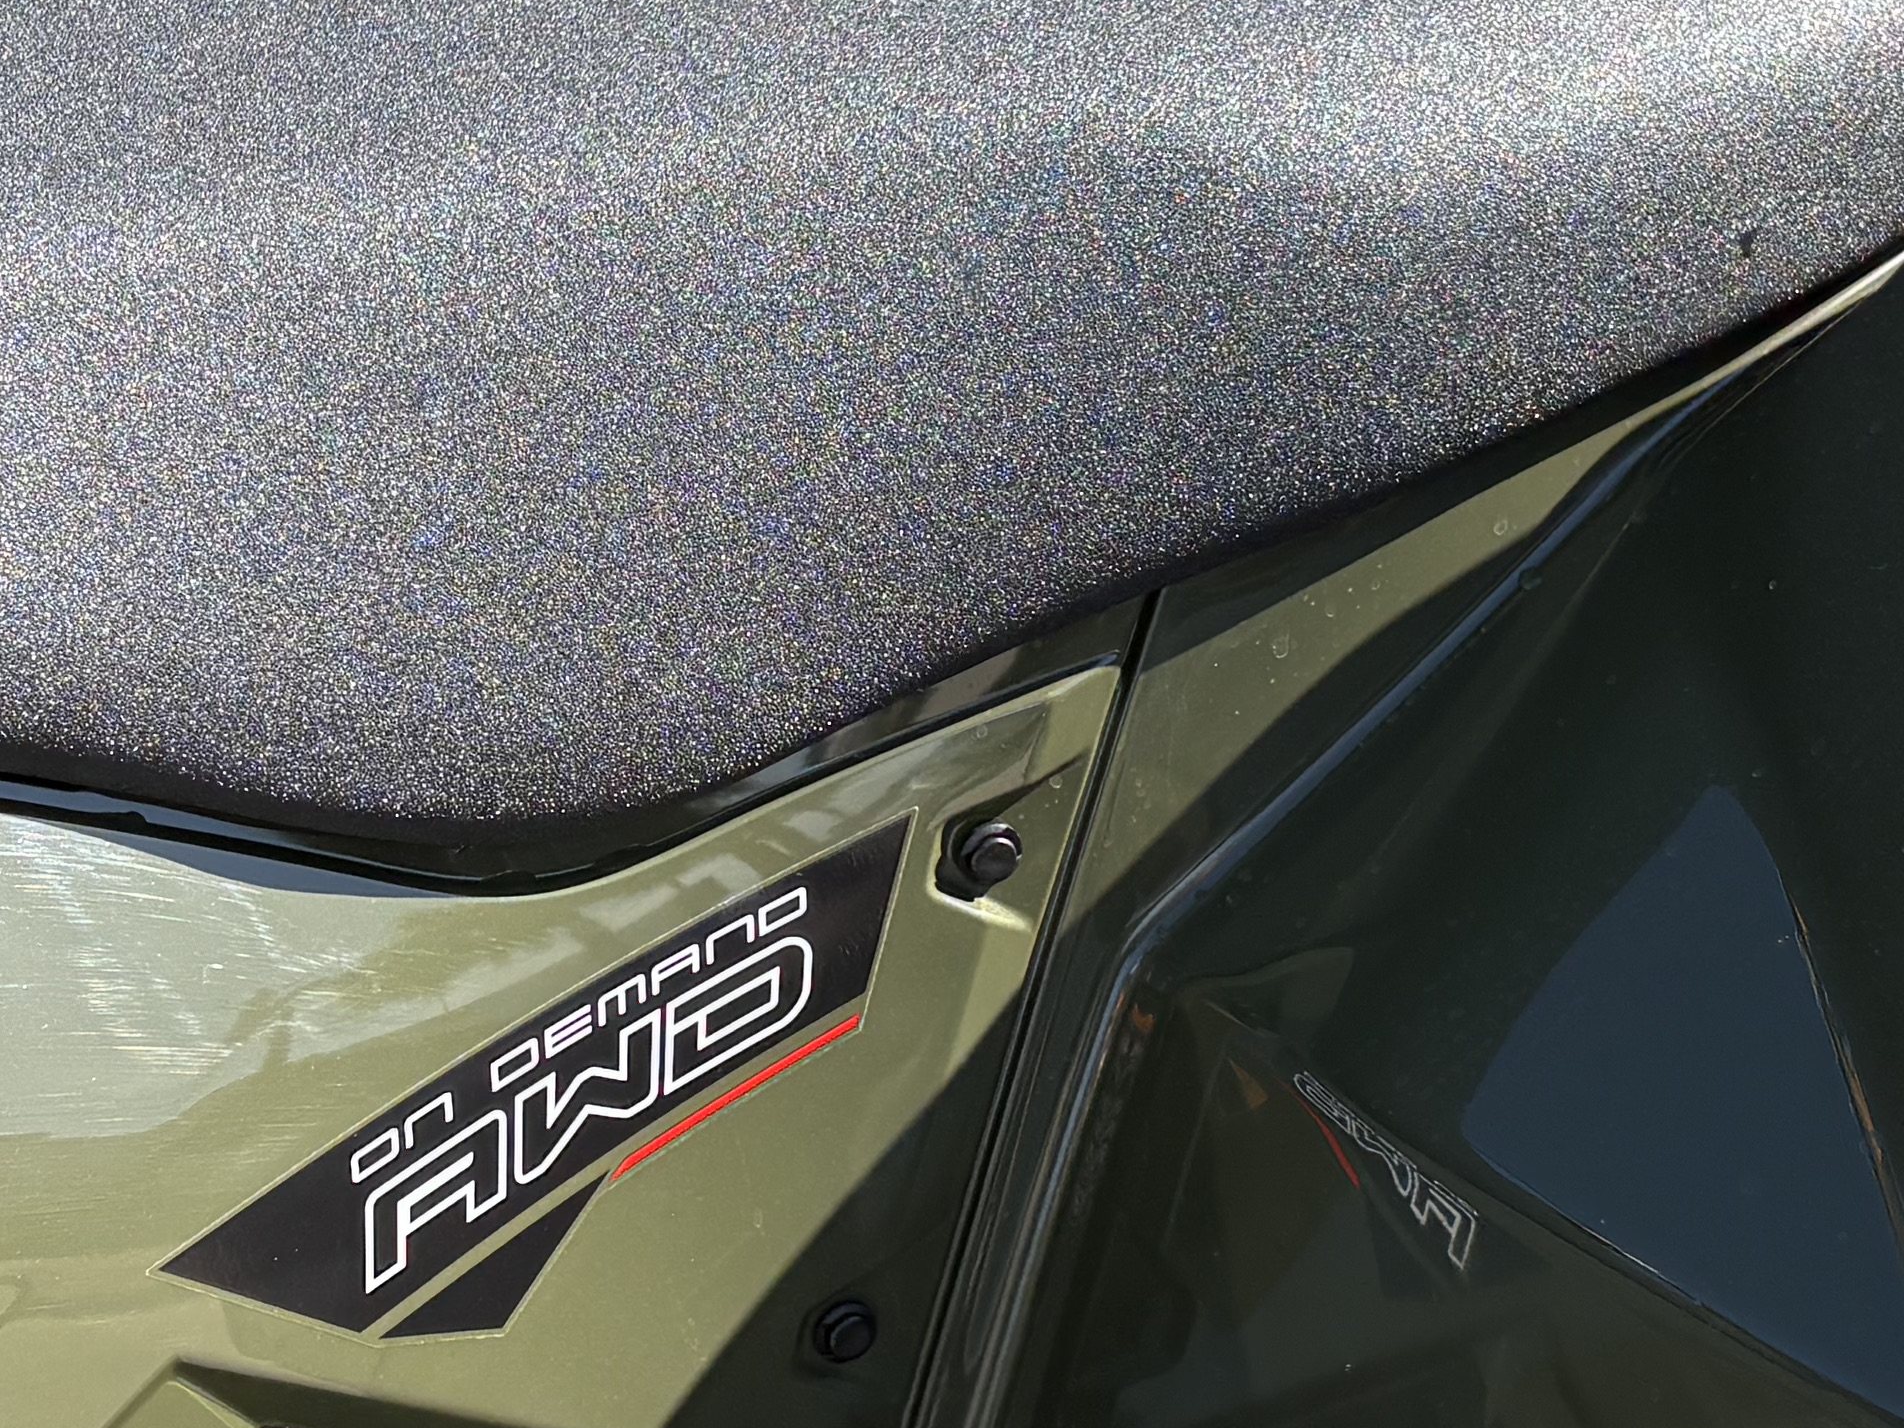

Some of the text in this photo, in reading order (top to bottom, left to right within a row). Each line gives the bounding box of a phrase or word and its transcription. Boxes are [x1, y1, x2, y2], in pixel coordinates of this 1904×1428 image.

[350, 886, 809, 1184] ON DEMAND
[364, 935, 815, 1295] AWD
